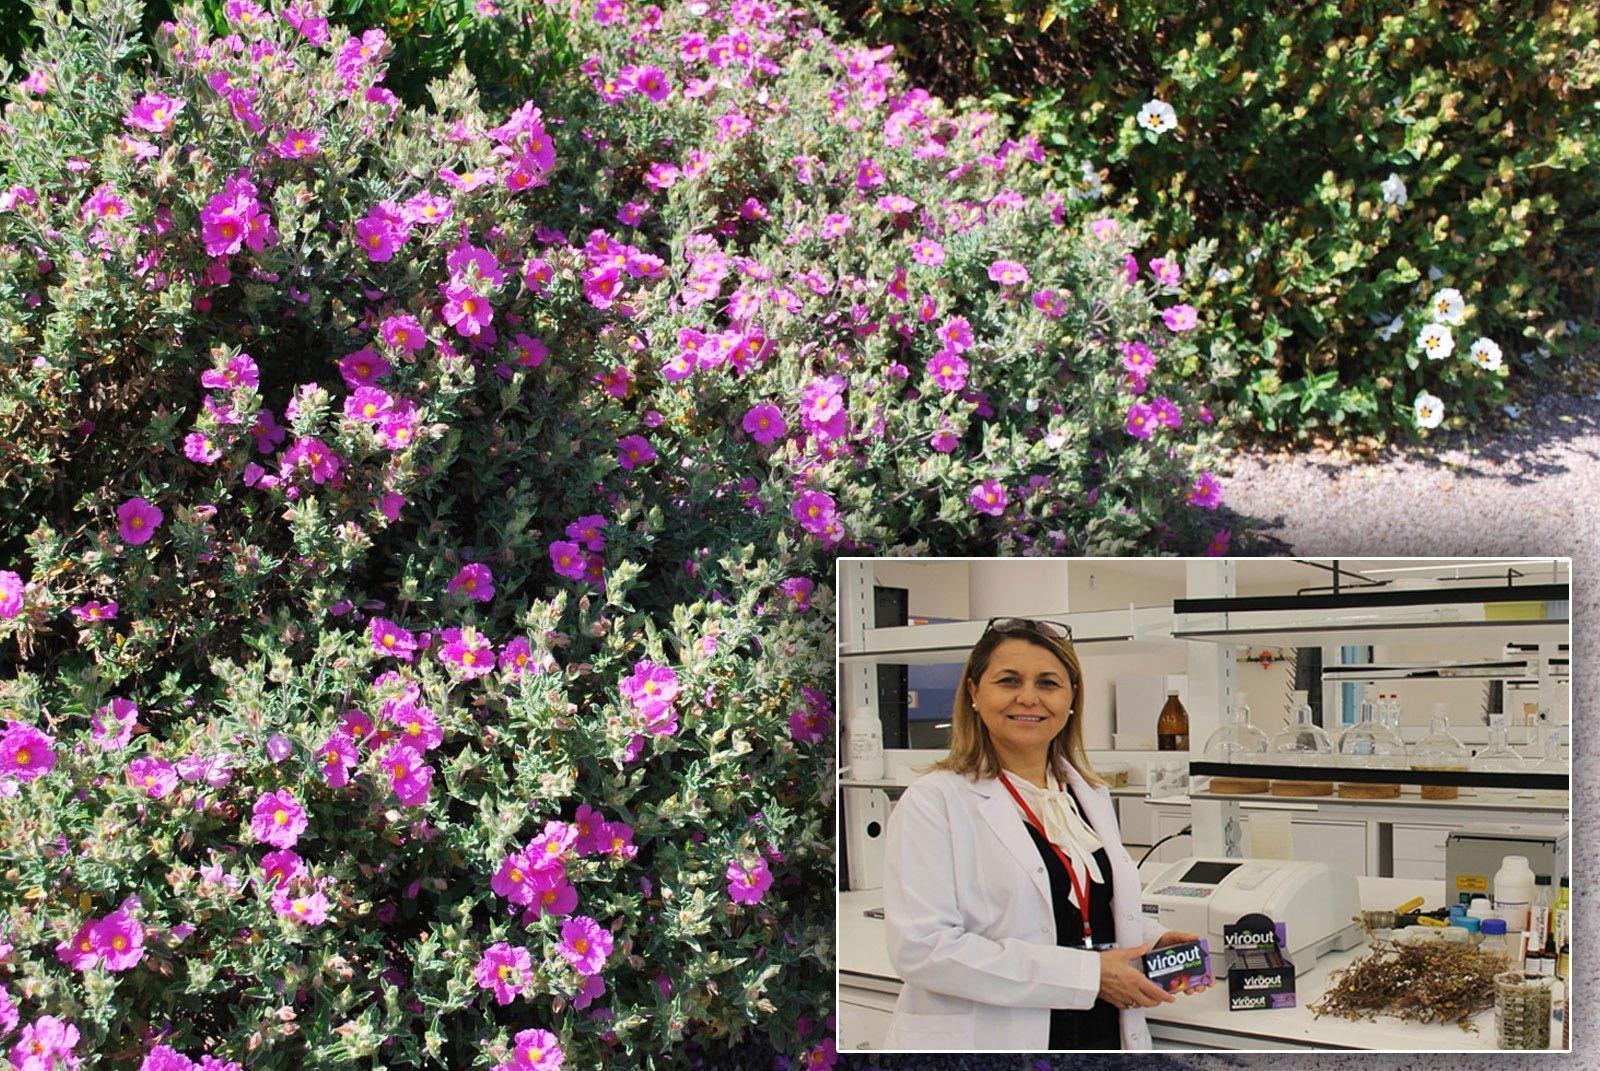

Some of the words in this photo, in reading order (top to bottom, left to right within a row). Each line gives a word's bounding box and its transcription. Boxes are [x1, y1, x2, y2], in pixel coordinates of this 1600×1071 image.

[1226, 931, 1275, 945] viroout
[1147, 946, 1200, 971] viroout
[1244, 975, 1282, 986] viroout
[1232, 996, 1266, 1006] viroout
